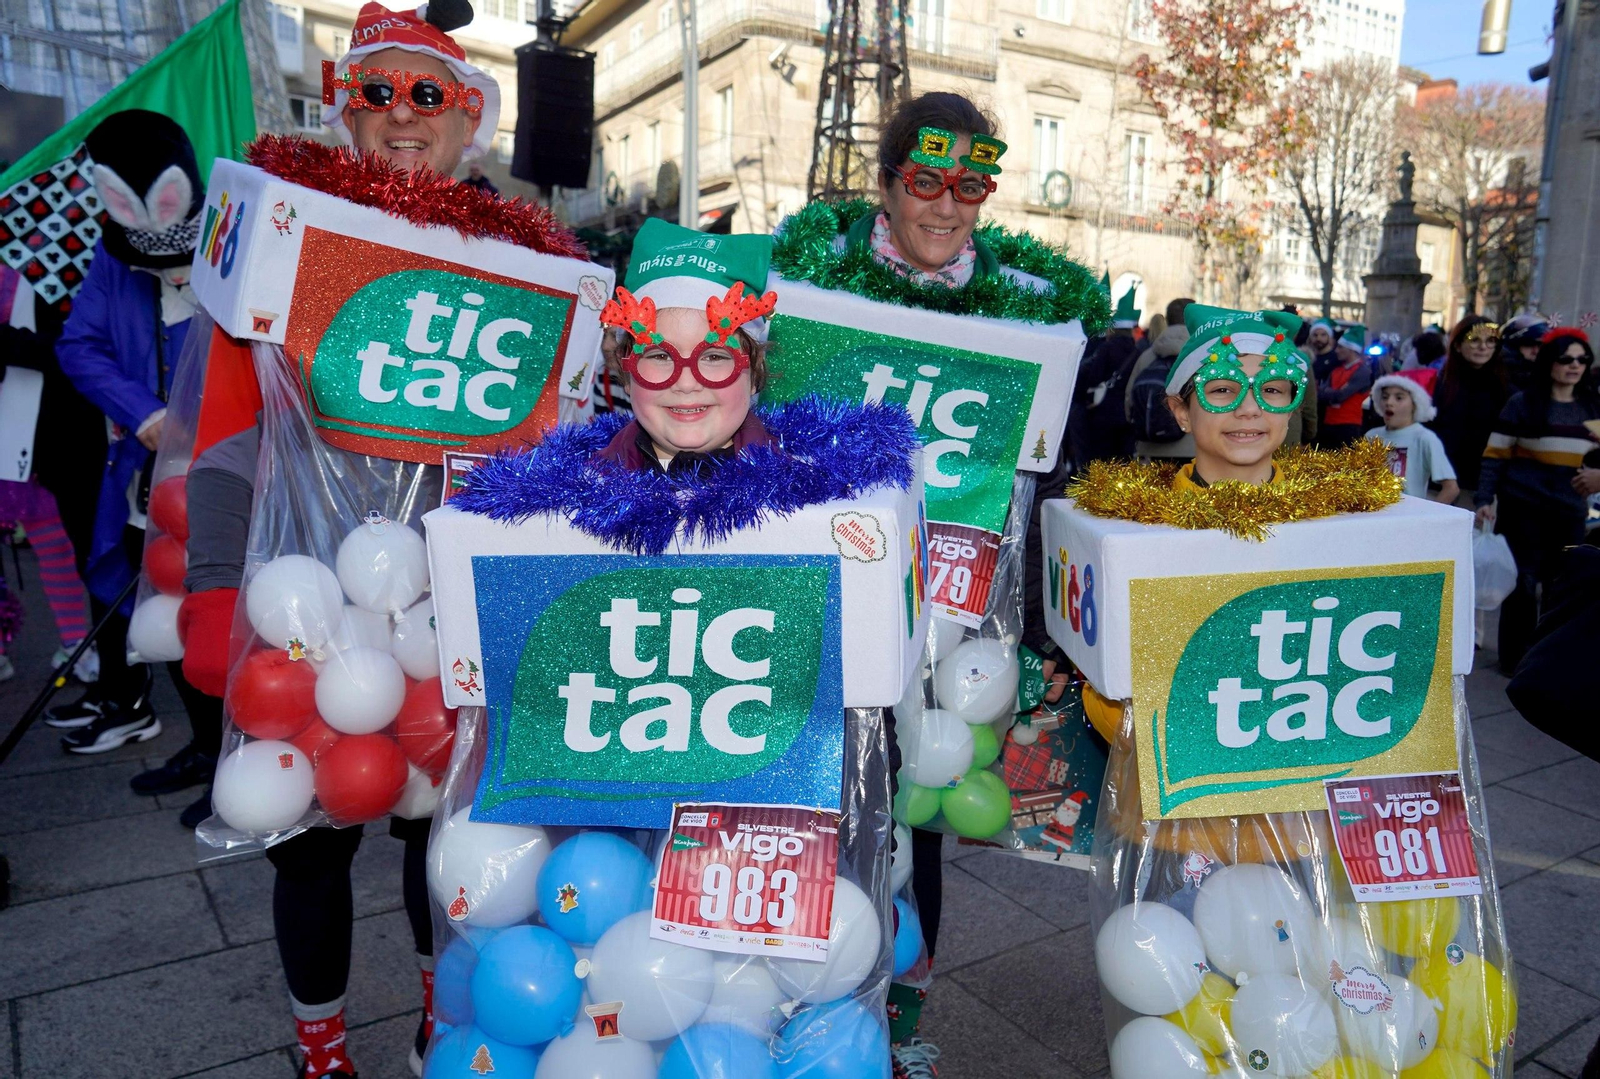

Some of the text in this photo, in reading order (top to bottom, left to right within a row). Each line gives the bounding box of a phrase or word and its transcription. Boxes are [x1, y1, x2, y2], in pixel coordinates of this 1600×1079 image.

[687, 254, 727, 273] auga
[404, 290, 533, 370] tic
[356, 340, 517, 421] tac
[862, 363, 989, 439] tic
[931, 560, 972, 605] 79
[600, 587, 775, 681] tic
[1250, 597, 1401, 680] tic
[558, 672, 772, 755] tac
[1208, 676, 1393, 748] tac
[1372, 799, 1440, 823] vigo
[1386, 792, 1431, 800] SILVESTRE
[718, 830, 803, 862] vigo
[737, 823, 795, 834] SILVESTRE
[1374, 826, 1447, 877] 981
[699, 863, 798, 927] 983
[1341, 988, 1383, 1001] Christmas
